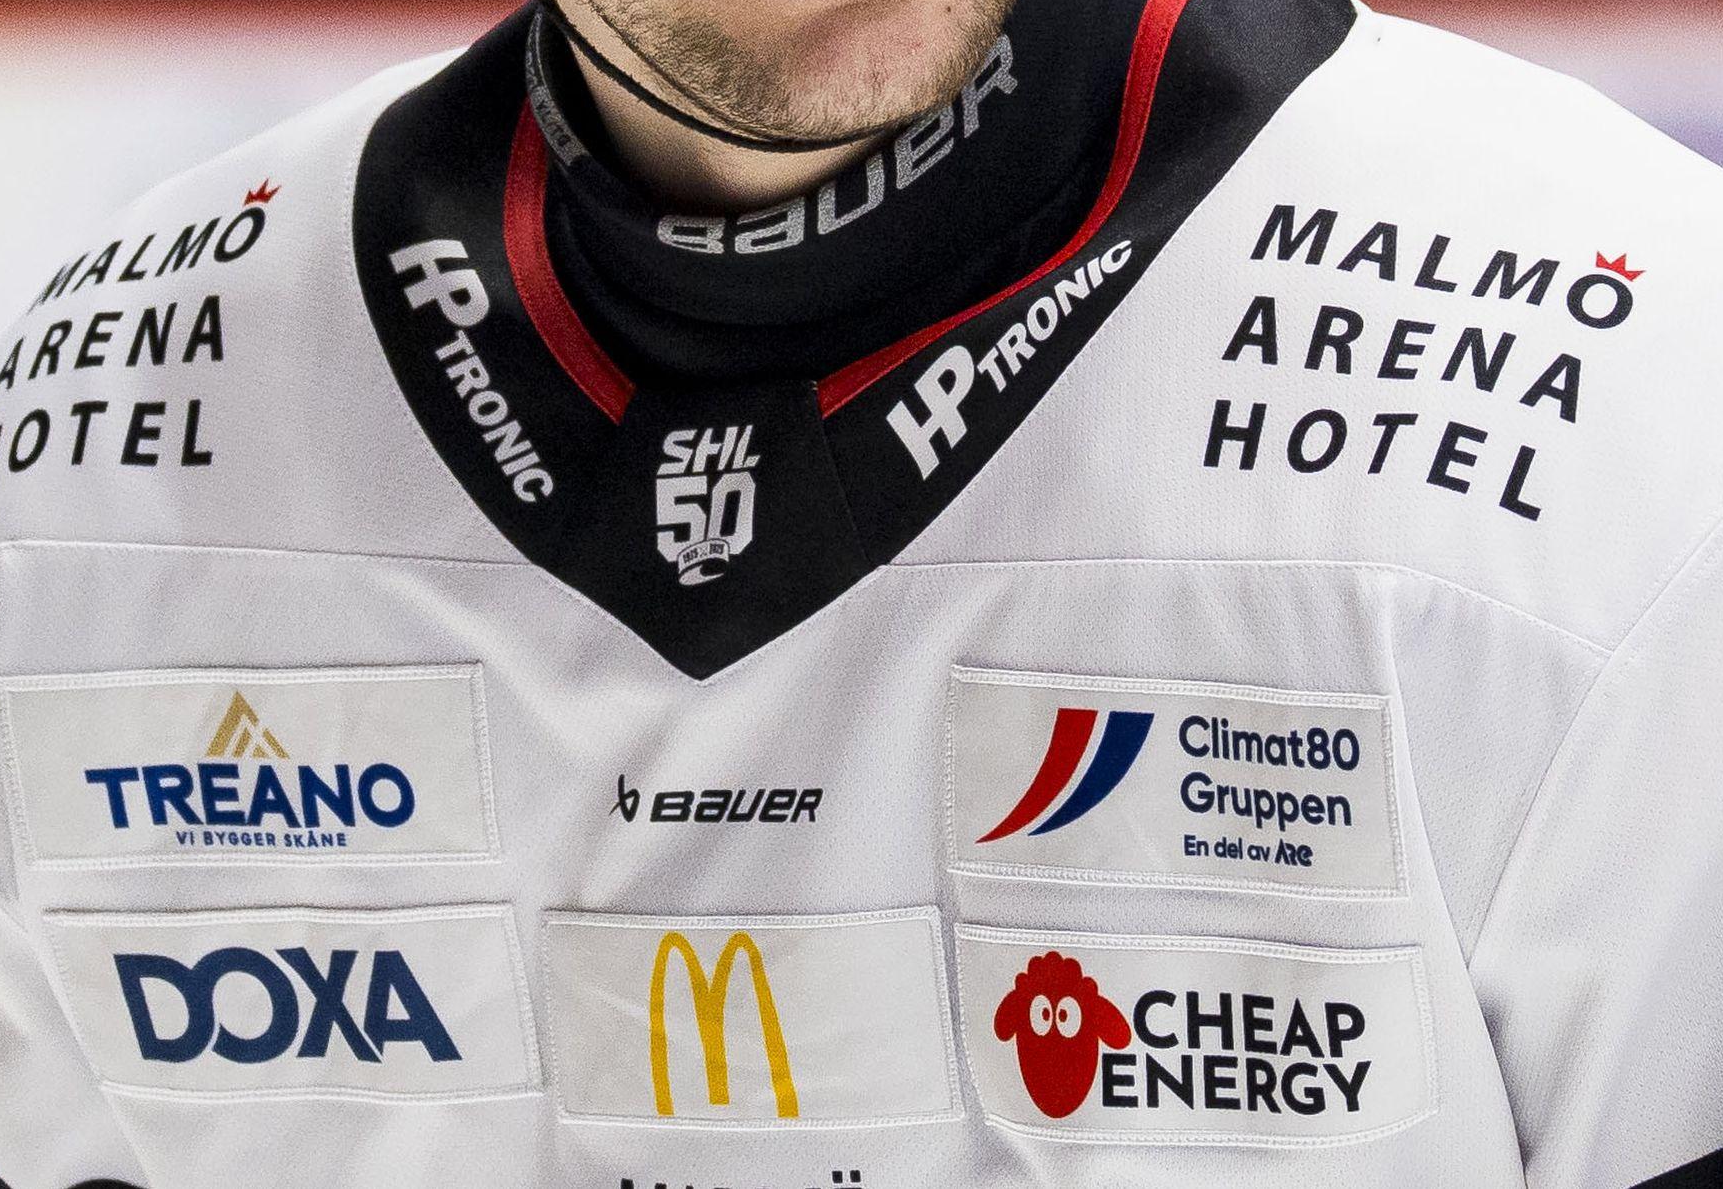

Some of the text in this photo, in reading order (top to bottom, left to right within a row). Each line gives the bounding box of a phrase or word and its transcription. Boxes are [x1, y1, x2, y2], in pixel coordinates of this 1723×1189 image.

[657, 33, 1018, 254] BAUER
[389, 239, 554, 503] HP TRONIC
[885, 240, 1132, 481] HP TRONIC
[1221, 295, 1582, 424] ARENA
[656, 424, 761, 476] SHL
[1203, 399, 1541, 522] HOTEL
[655, 471, 756, 563] 50
[1178, 715, 1361, 771] Climat80
[85, 762, 416, 829] TREANO
[650, 788, 824, 823] BAUER
[1180, 771, 1353, 832] Gruppen
[176, 830, 347, 848] VI BYGGER SKÅNE
[1183, 834, 1210, 857] En
[1213, 837, 1243, 860] del
[1247, 844, 1271, 862] av
[113, 946, 463, 1065] DOXA
[1132, 990, 1367, 1059] CHEAP
[1101, 1054, 1372, 1113] ENERGY
